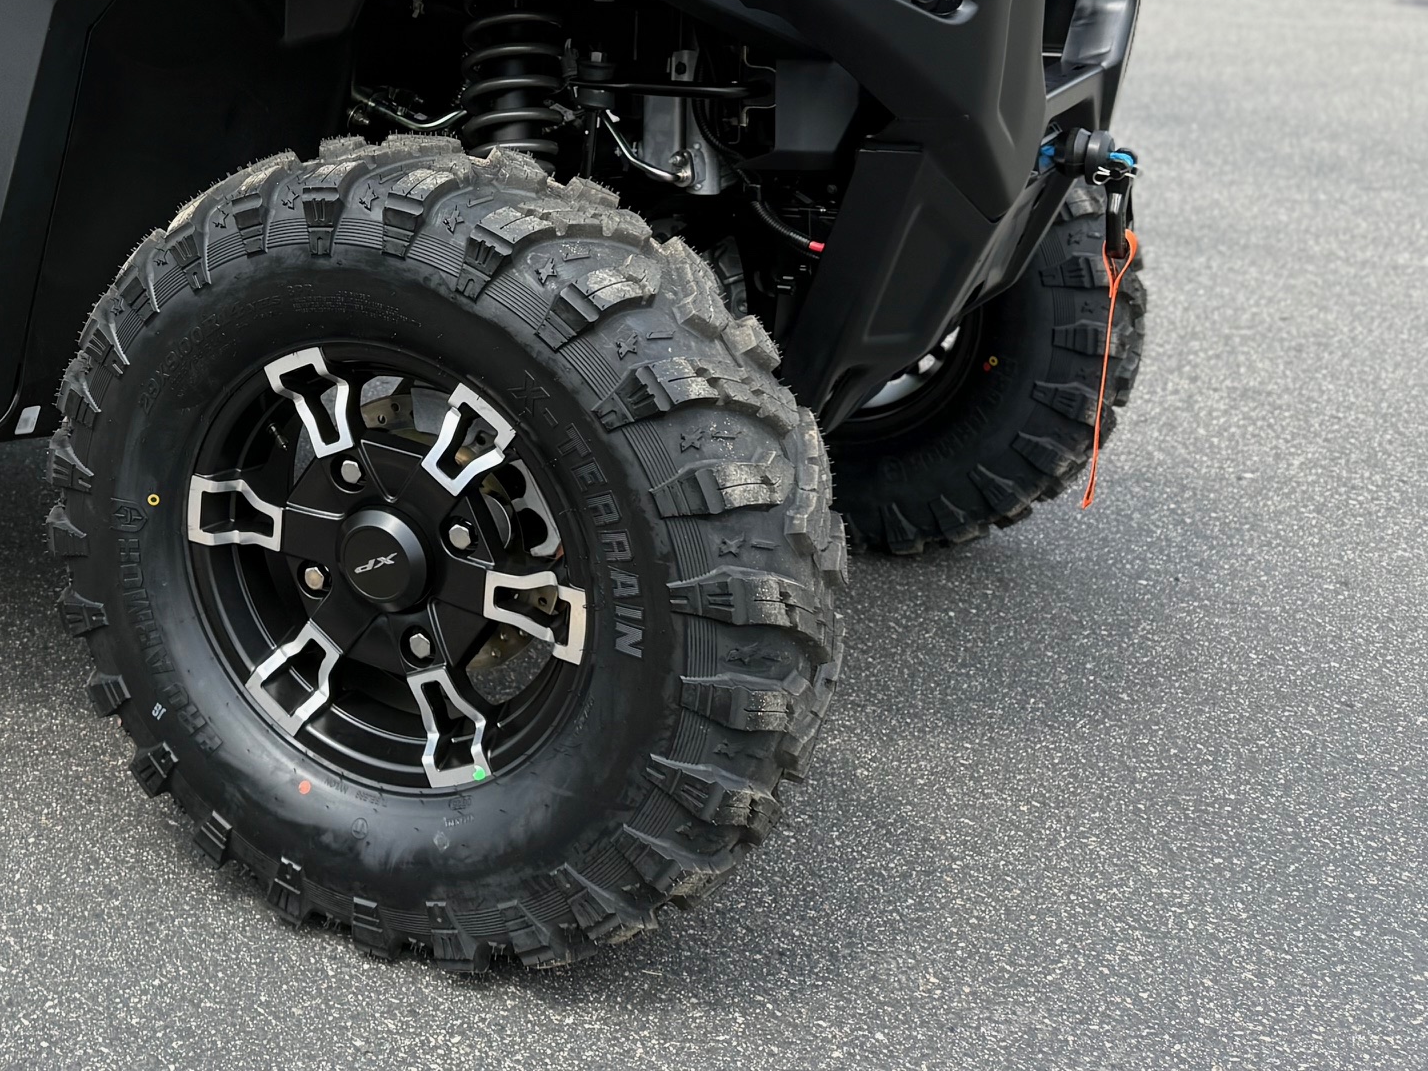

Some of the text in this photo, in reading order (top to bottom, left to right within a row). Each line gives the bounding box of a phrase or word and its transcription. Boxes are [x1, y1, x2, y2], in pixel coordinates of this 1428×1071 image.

[353, 552, 398, 575] XP
[506, 369, 644, 660] X-TERRAIN
[117, 538, 176, 675] ARMOR
